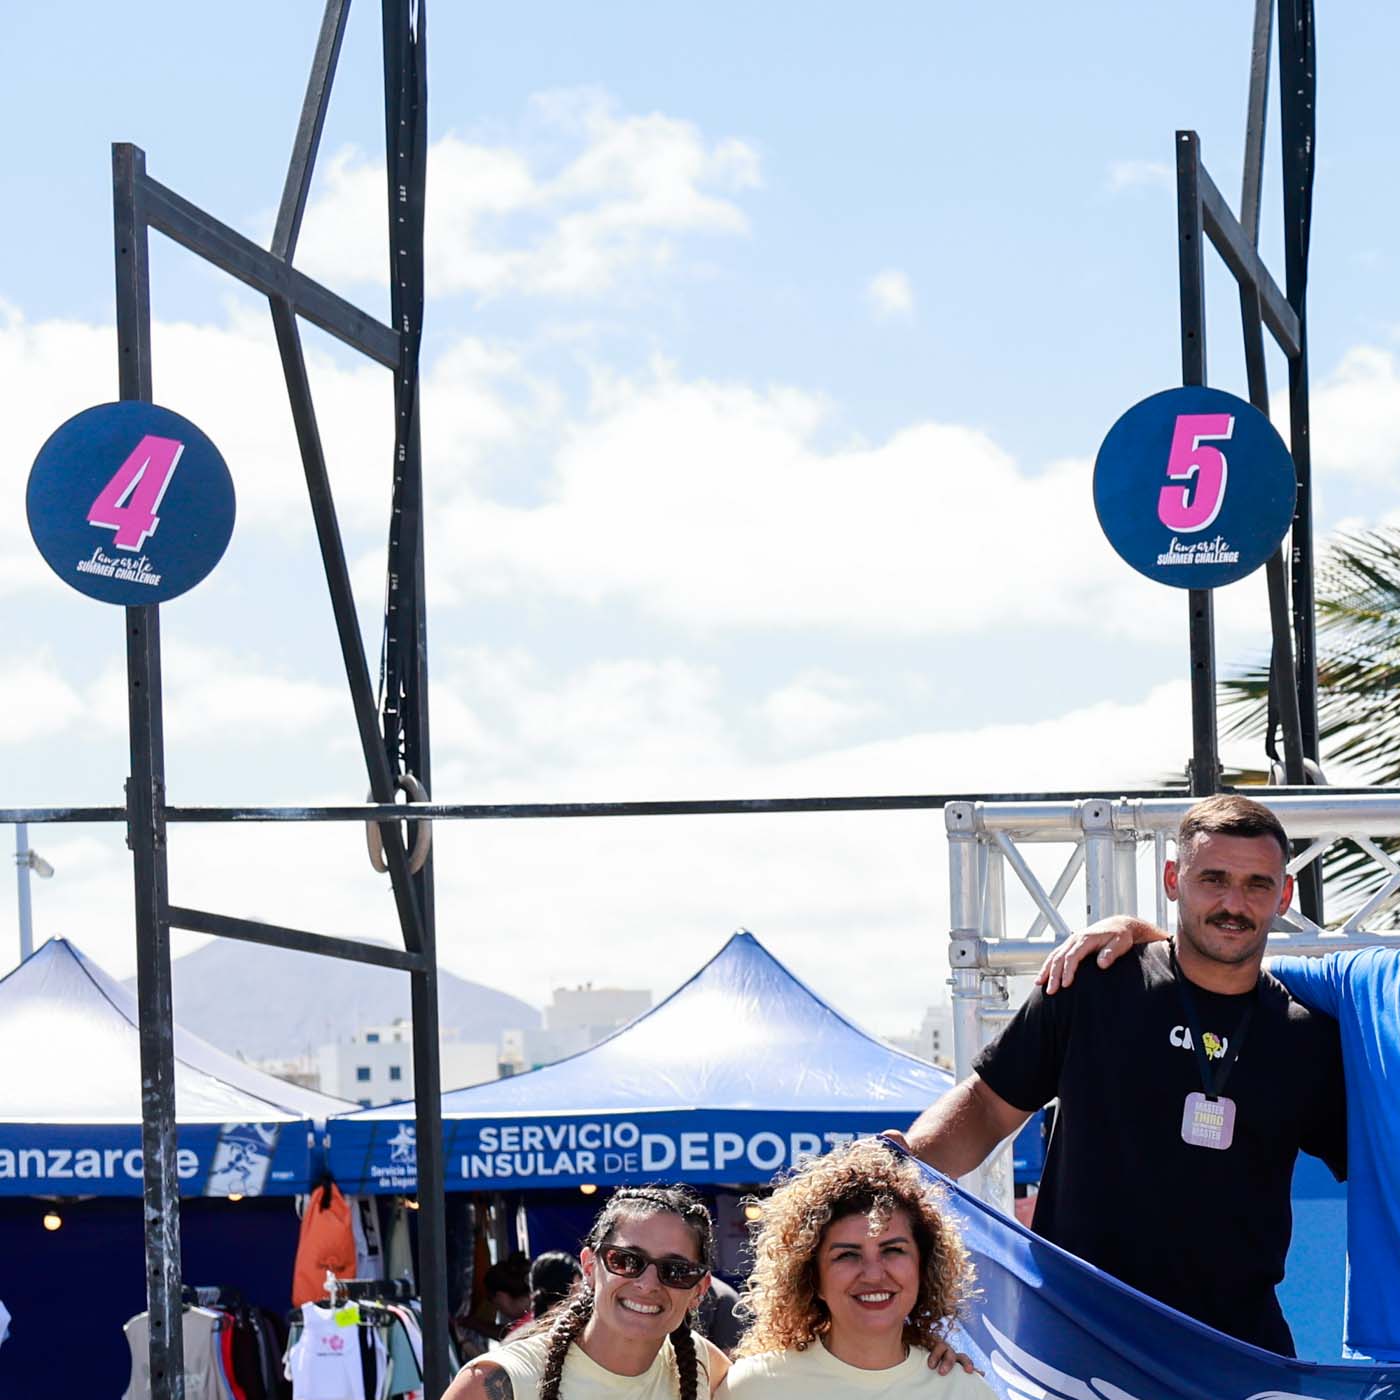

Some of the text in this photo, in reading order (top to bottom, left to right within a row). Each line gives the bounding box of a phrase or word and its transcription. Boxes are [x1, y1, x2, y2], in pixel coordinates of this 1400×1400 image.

[1158, 413, 1235, 533] 5
[87, 435, 185, 553] 4
[1157, 550, 1240, 565] SUMMER CHALLENGE
[76, 560, 162, 586] SUMMER CHALLENGE
[478, 1122, 640, 1153] SERVICIO
[461, 1151, 597, 1178] INSULAR
[604, 1152, 639, 1174] DE
